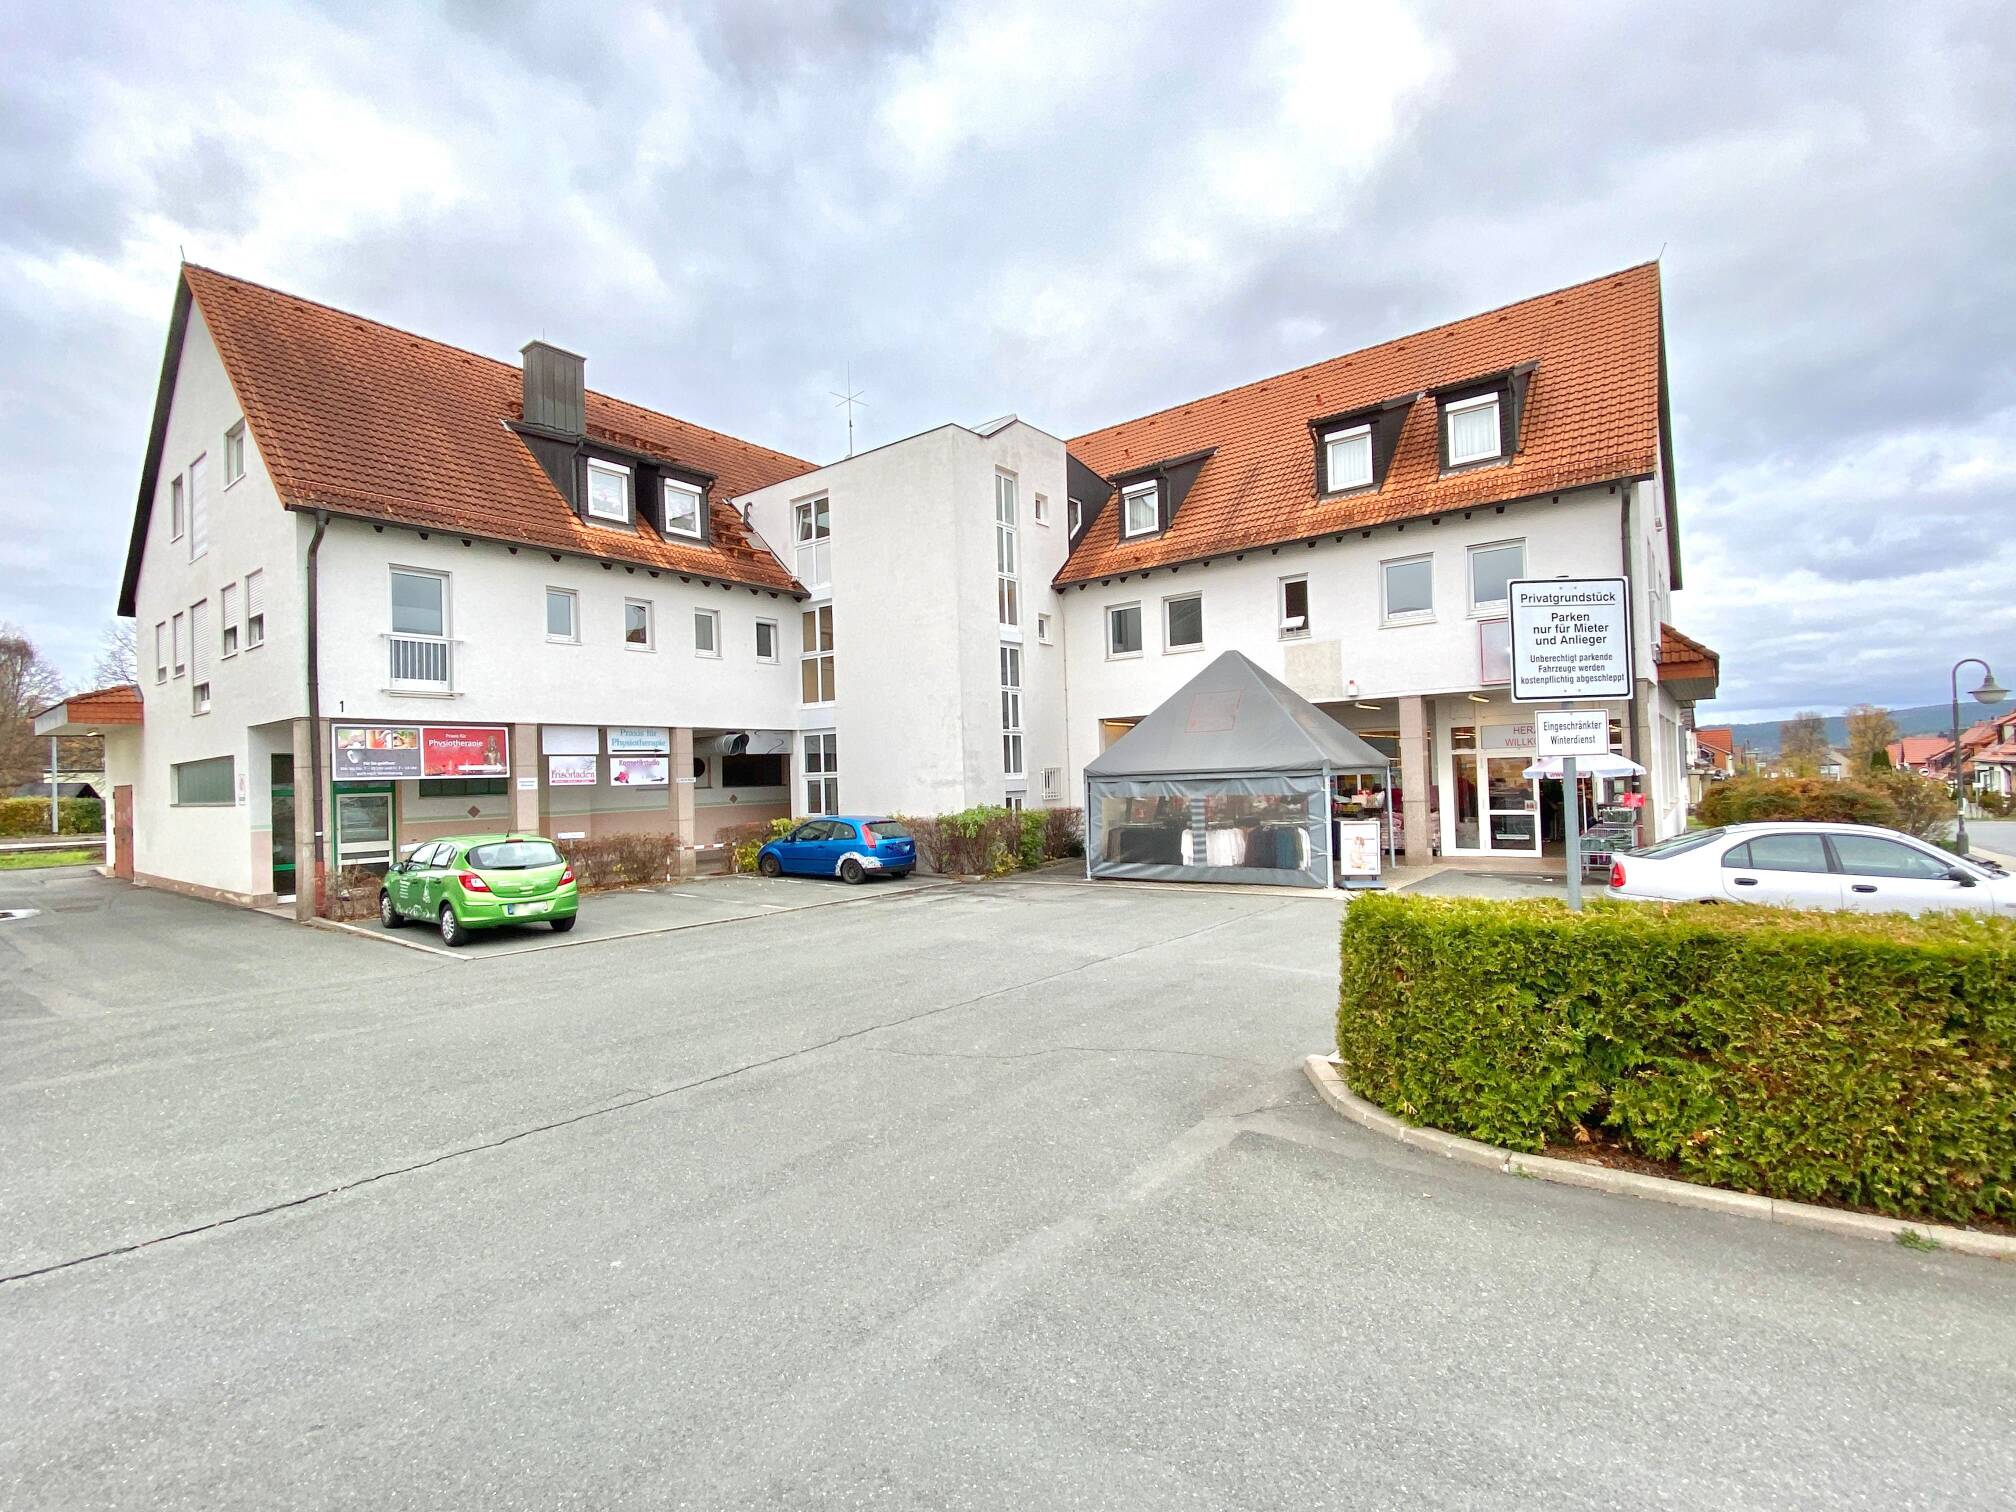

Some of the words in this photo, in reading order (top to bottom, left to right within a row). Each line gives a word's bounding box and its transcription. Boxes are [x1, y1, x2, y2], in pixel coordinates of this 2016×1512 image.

[1520, 592, 1616, 605] Privatgrundstück
[1551, 612, 1590, 622] Parken
[1533, 626, 1552, 634] nur
[1555, 624, 1570, 634] für
[1574, 623, 1609, 633] Mieter
[1535, 636, 1557, 646] und
[1560, 635, 1607, 647] Anlieger
[1530, 654, 1577, 663] Unberechtigt
[1579, 653, 1613, 663] parkende
[1538, 664, 1576, 674] Fahrzeuge
[1578, 663, 1606, 672] werden
[1520, 675, 1574, 686] kostenpflichtig
[1576, 673, 1625, 684] abgeschleppt
[339, 700, 345, 713] 1
[1513, 725, 1536, 735] HER
[1543, 720, 1602, 732] Eingeschränkter
[428, 739, 484, 748] Physiotherapie
[611, 738, 666, 748] Physiotherapie
[1550, 735, 1596, 745] Winterdienst
